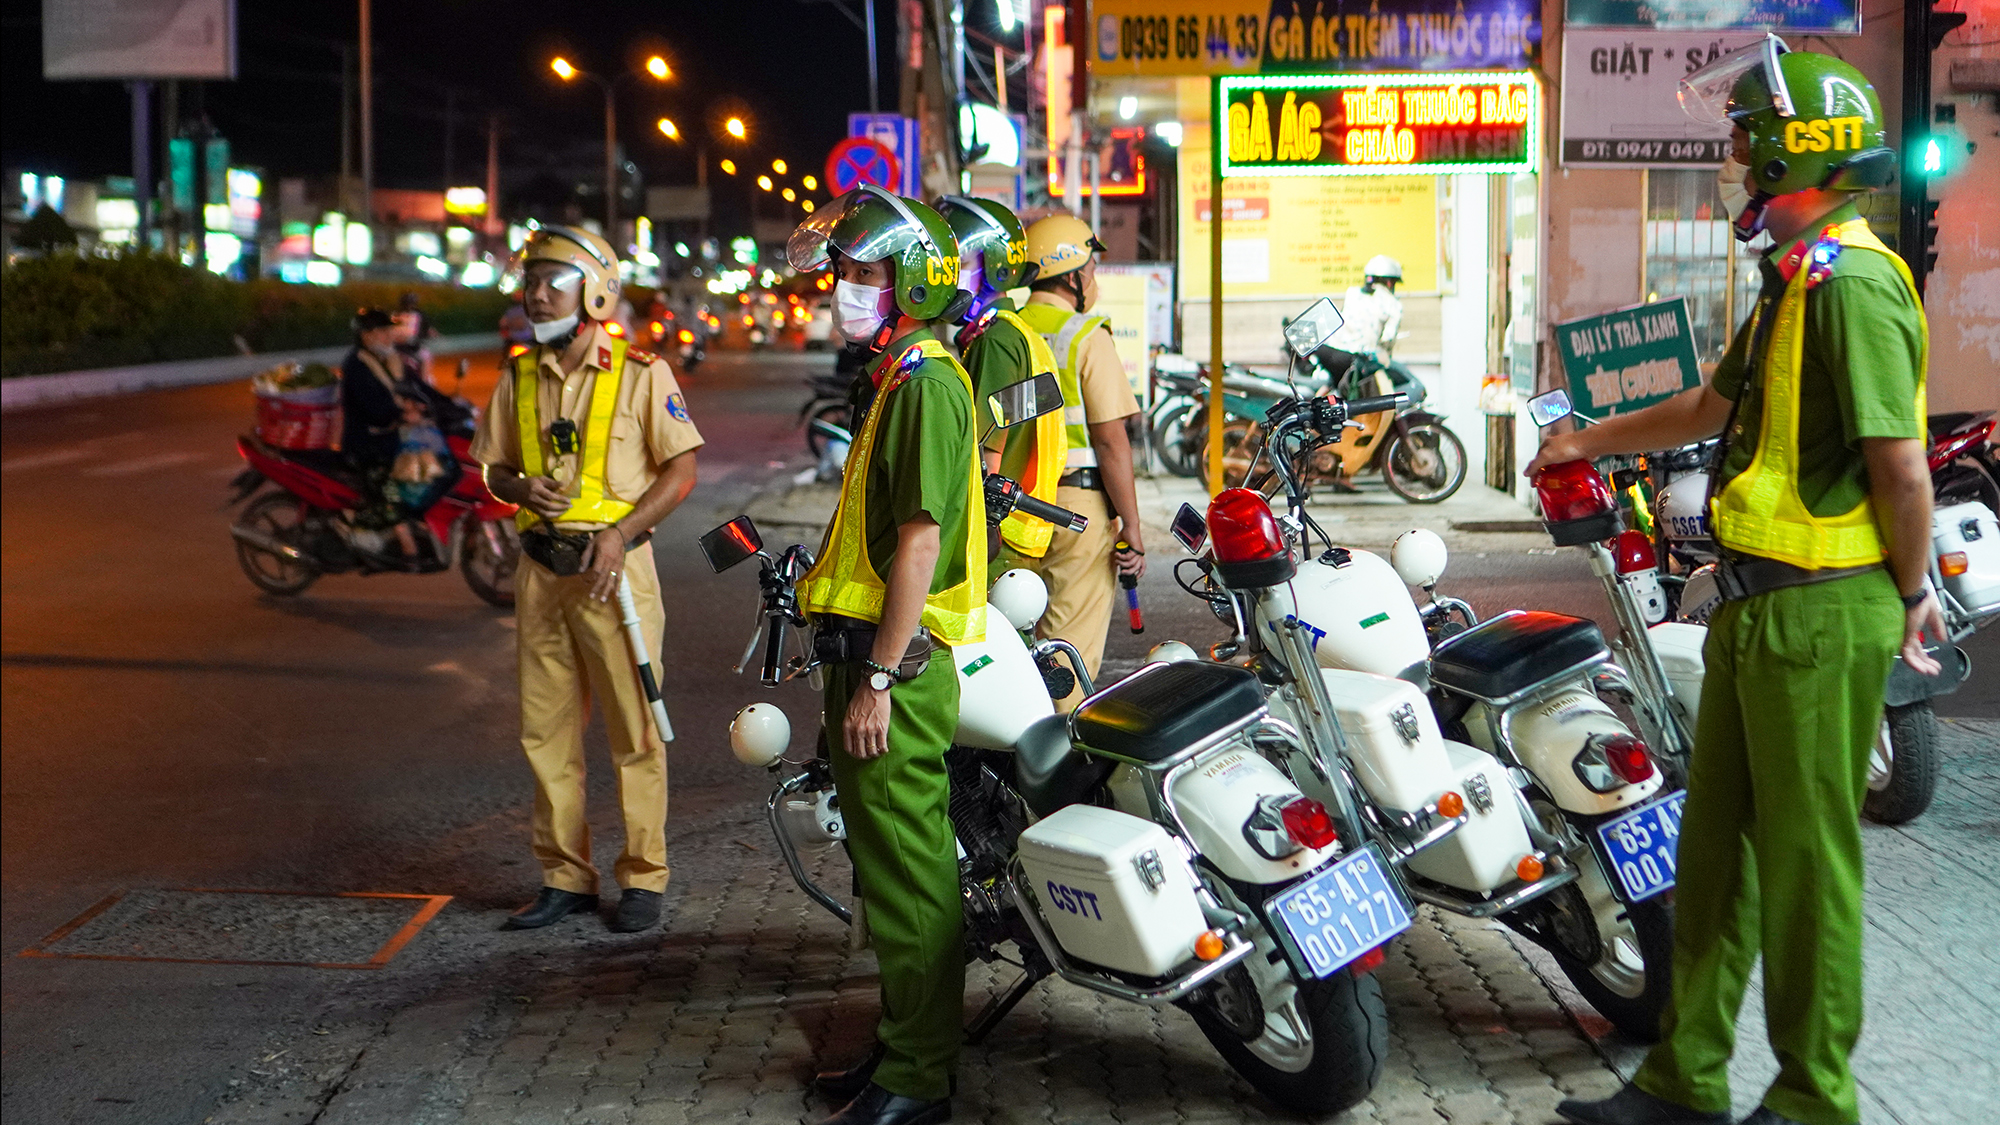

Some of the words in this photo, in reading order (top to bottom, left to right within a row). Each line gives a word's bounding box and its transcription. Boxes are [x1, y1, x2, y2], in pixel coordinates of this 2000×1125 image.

[1121, 15, 1168, 59] 0939
[1176, 15, 1198, 59] 66
[1205, 15, 1229, 59] 44
[1236, 14, 1259, 59] 33
[1269, 1, 1305, 60] GÀ
[1311, 1, 1341, 58] ÁC
[1590, 41, 1653, 81] GIẶT
[1228, 91, 1273, 162] GÀ
[1277, 91, 1321, 161] ÁC
[1345, 125, 1416, 164] CHÁO
[1475, 129, 1526, 159] SEN
[1785, 116, 1864, 153] CSTT
[1617, 142, 1663, 158] 0947
[1669, 142, 1705, 158] 049
[1570, 328, 1596, 363] ĐẠI
[1595, 317, 1612, 350] LÝ
[1614, 313, 1643, 348] TRÀ
[1642, 310, 1680, 343] XANH
[1541, 696, 1581, 717] YAMAHA
[1203, 754, 1245, 778] YAMAHA
[1047, 880, 1102, 921] CSTT
[1294, 861, 1370, 926] 65-A1
[1305, 890, 1396, 968] 001.77
